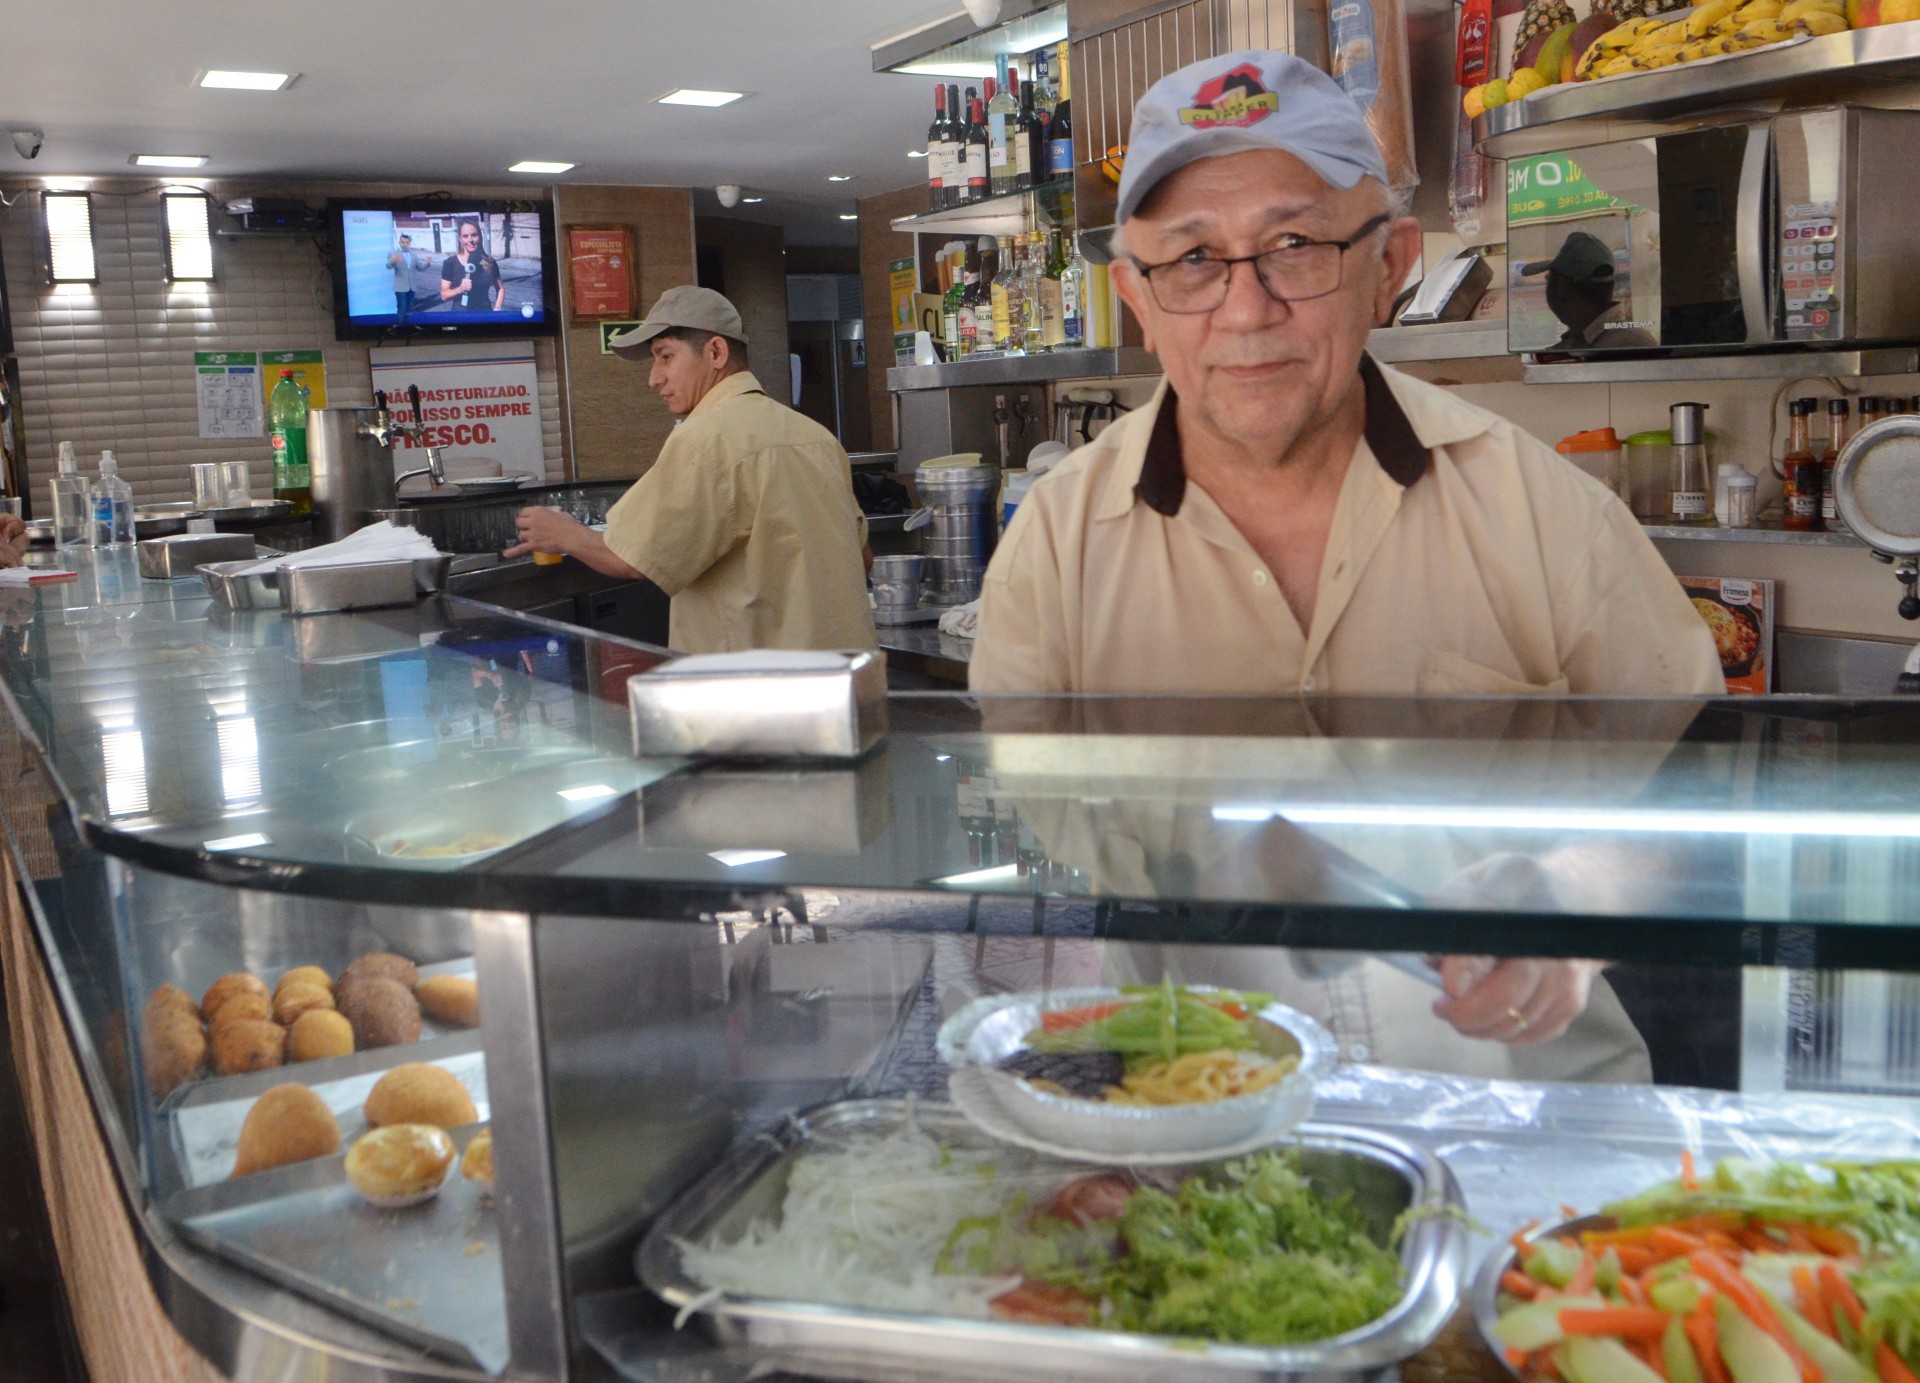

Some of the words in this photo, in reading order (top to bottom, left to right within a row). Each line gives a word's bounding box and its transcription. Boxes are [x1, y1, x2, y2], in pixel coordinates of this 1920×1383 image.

[1604, 320, 1655, 330] BRASTEMP
[418, 384, 530, 402] PASTEURIZADO.
[465, 402, 532, 419] SEMPRE
[1723, 586, 1750, 597] Frimesa
